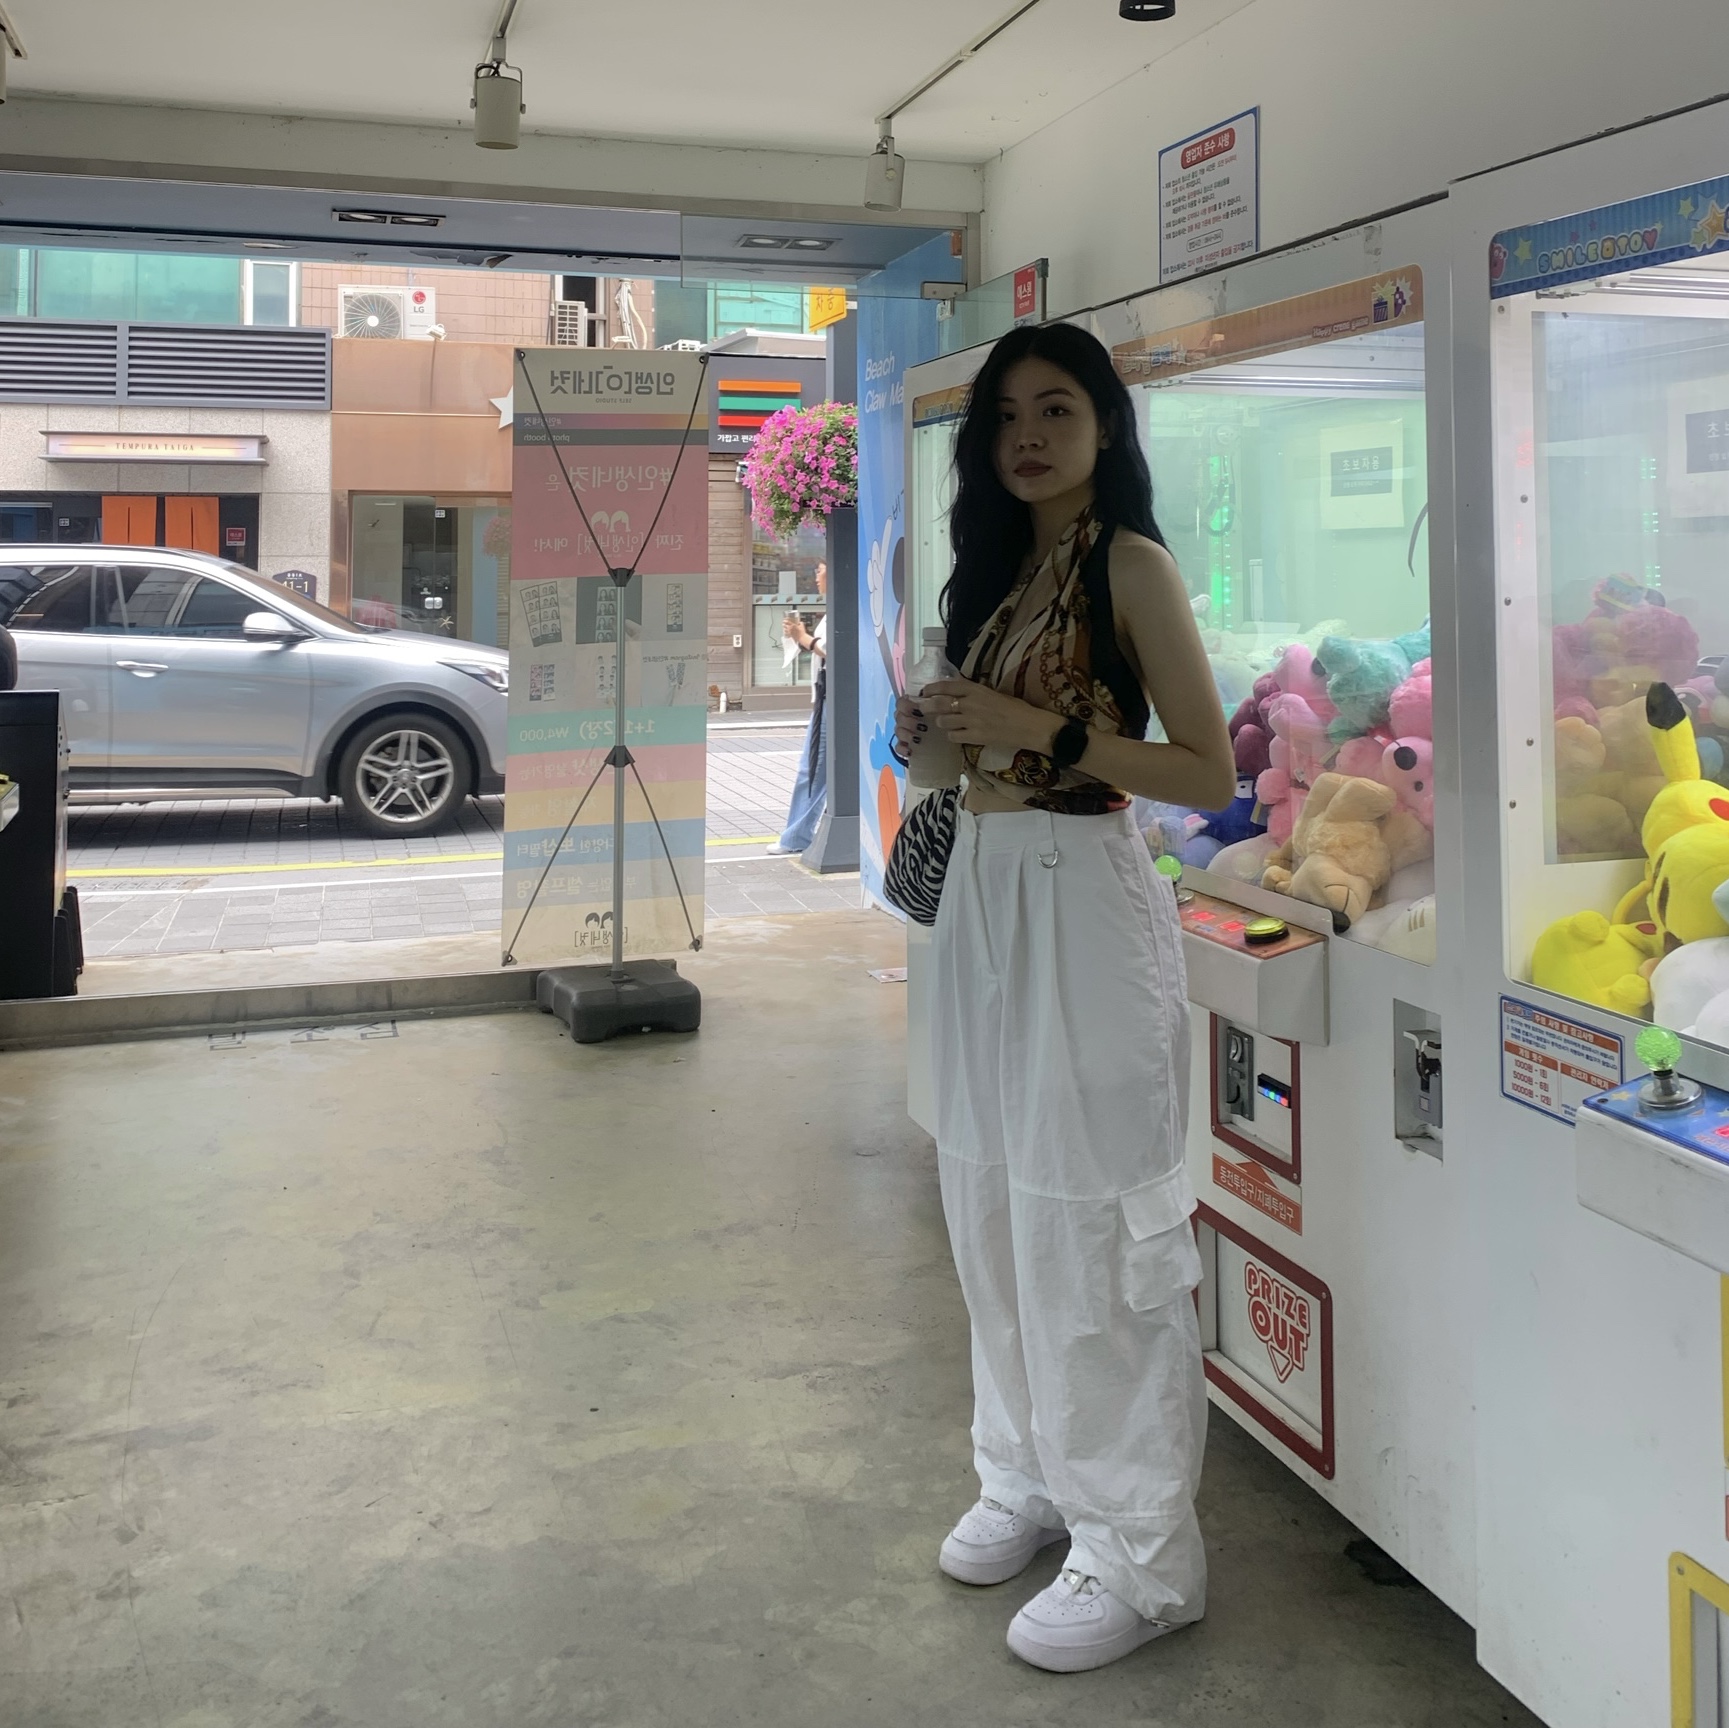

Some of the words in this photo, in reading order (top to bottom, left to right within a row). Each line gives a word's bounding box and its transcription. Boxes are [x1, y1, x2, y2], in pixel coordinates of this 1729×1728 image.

[1186, 145, 1202, 163] 영업자
[1204, 141, 1215, 155] 준수
[1538, 241, 1599, 273] SMILE
[1016, 281, 1032, 299] 에스원
[865, 350, 895, 382] Beach
[865, 389, 887, 414] Claw
[116, 442, 159, 450] TEMPURA
[164, 443, 194, 451] TAIGA
[717, 434, 740, 443] 가깝고
[1342, 455, 1380, 471] 초보자용
[1220, 1165, 1294, 1224] 동전투입구/지폐투입구
[1245, 1261, 1310, 1333] PRIZE
[1249, 1297, 1310, 1372] OUT
